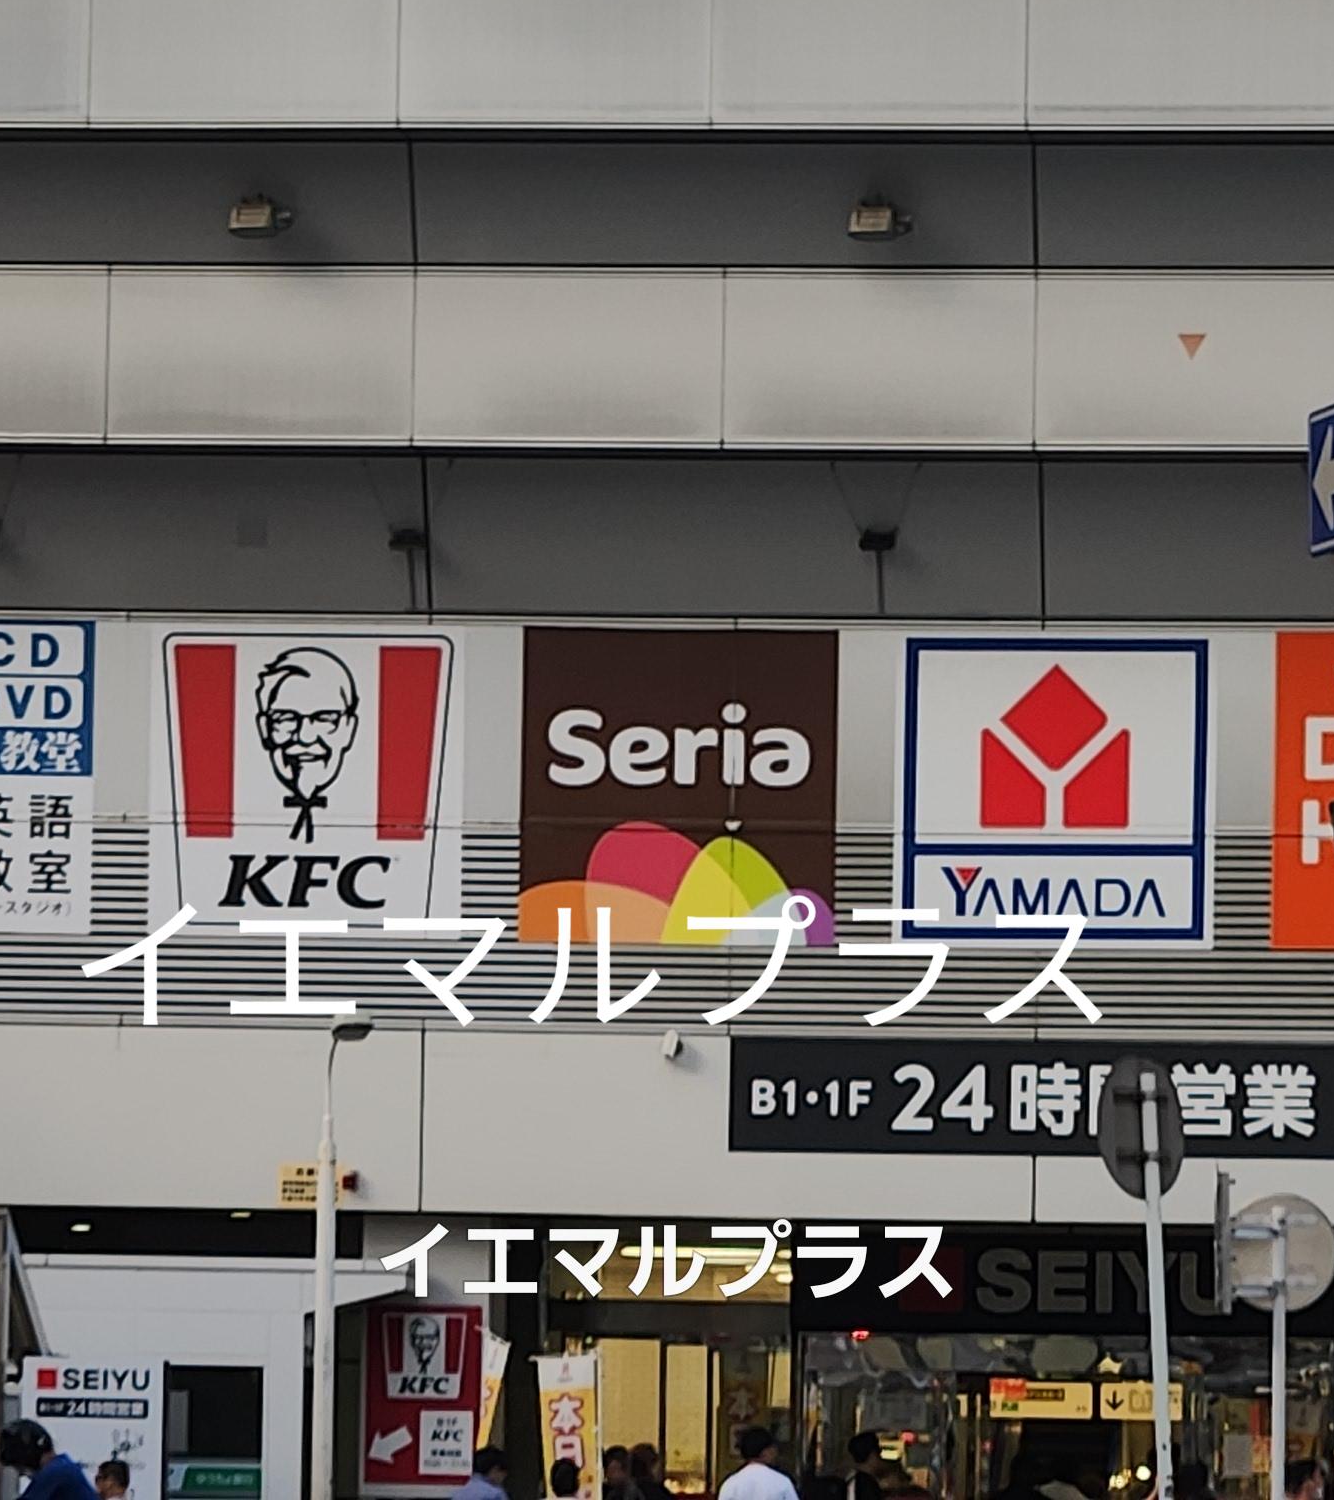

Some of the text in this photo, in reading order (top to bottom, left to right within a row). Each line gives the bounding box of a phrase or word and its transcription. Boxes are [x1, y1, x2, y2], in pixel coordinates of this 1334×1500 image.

[548, 703, 811, 788] Seria
[219, 854, 391, 909] KFC
[942, 866, 1167, 918] YAMADA
[890, 1061, 1318, 1138] 24時営業
[63, 1368, 150, 1391] SEIYU
[398, 1376, 450, 1395] KFC
